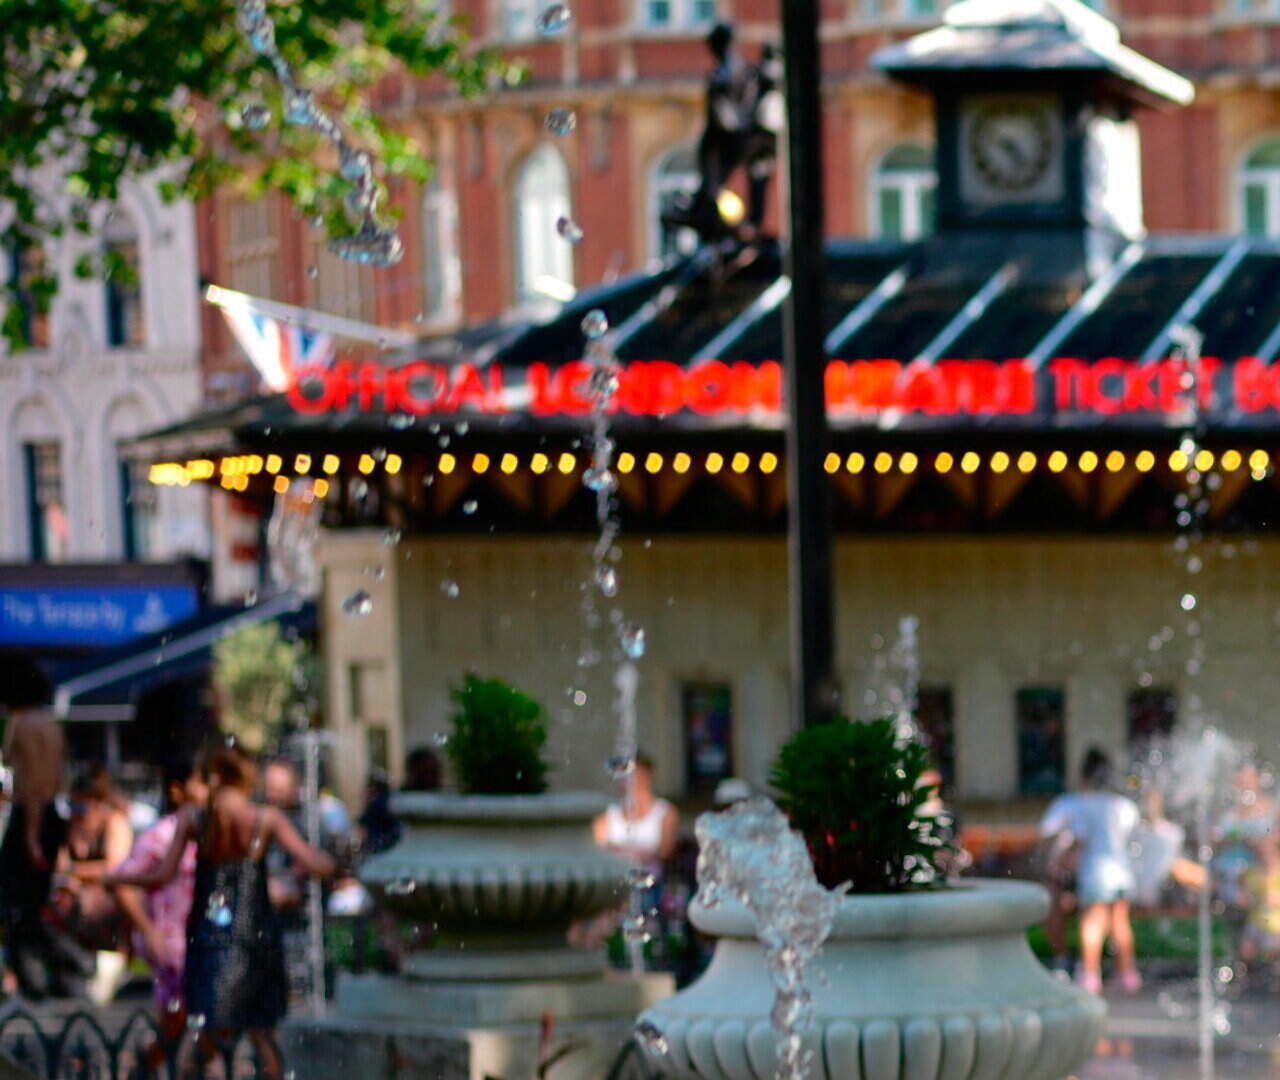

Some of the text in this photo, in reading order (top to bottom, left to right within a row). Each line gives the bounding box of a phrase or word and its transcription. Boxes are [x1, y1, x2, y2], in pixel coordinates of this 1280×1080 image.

[287, 360, 508, 414] OFFICIAL
[823, 358, 1037, 415] HEATRE
[1047, 357, 1222, 412] TICKET
